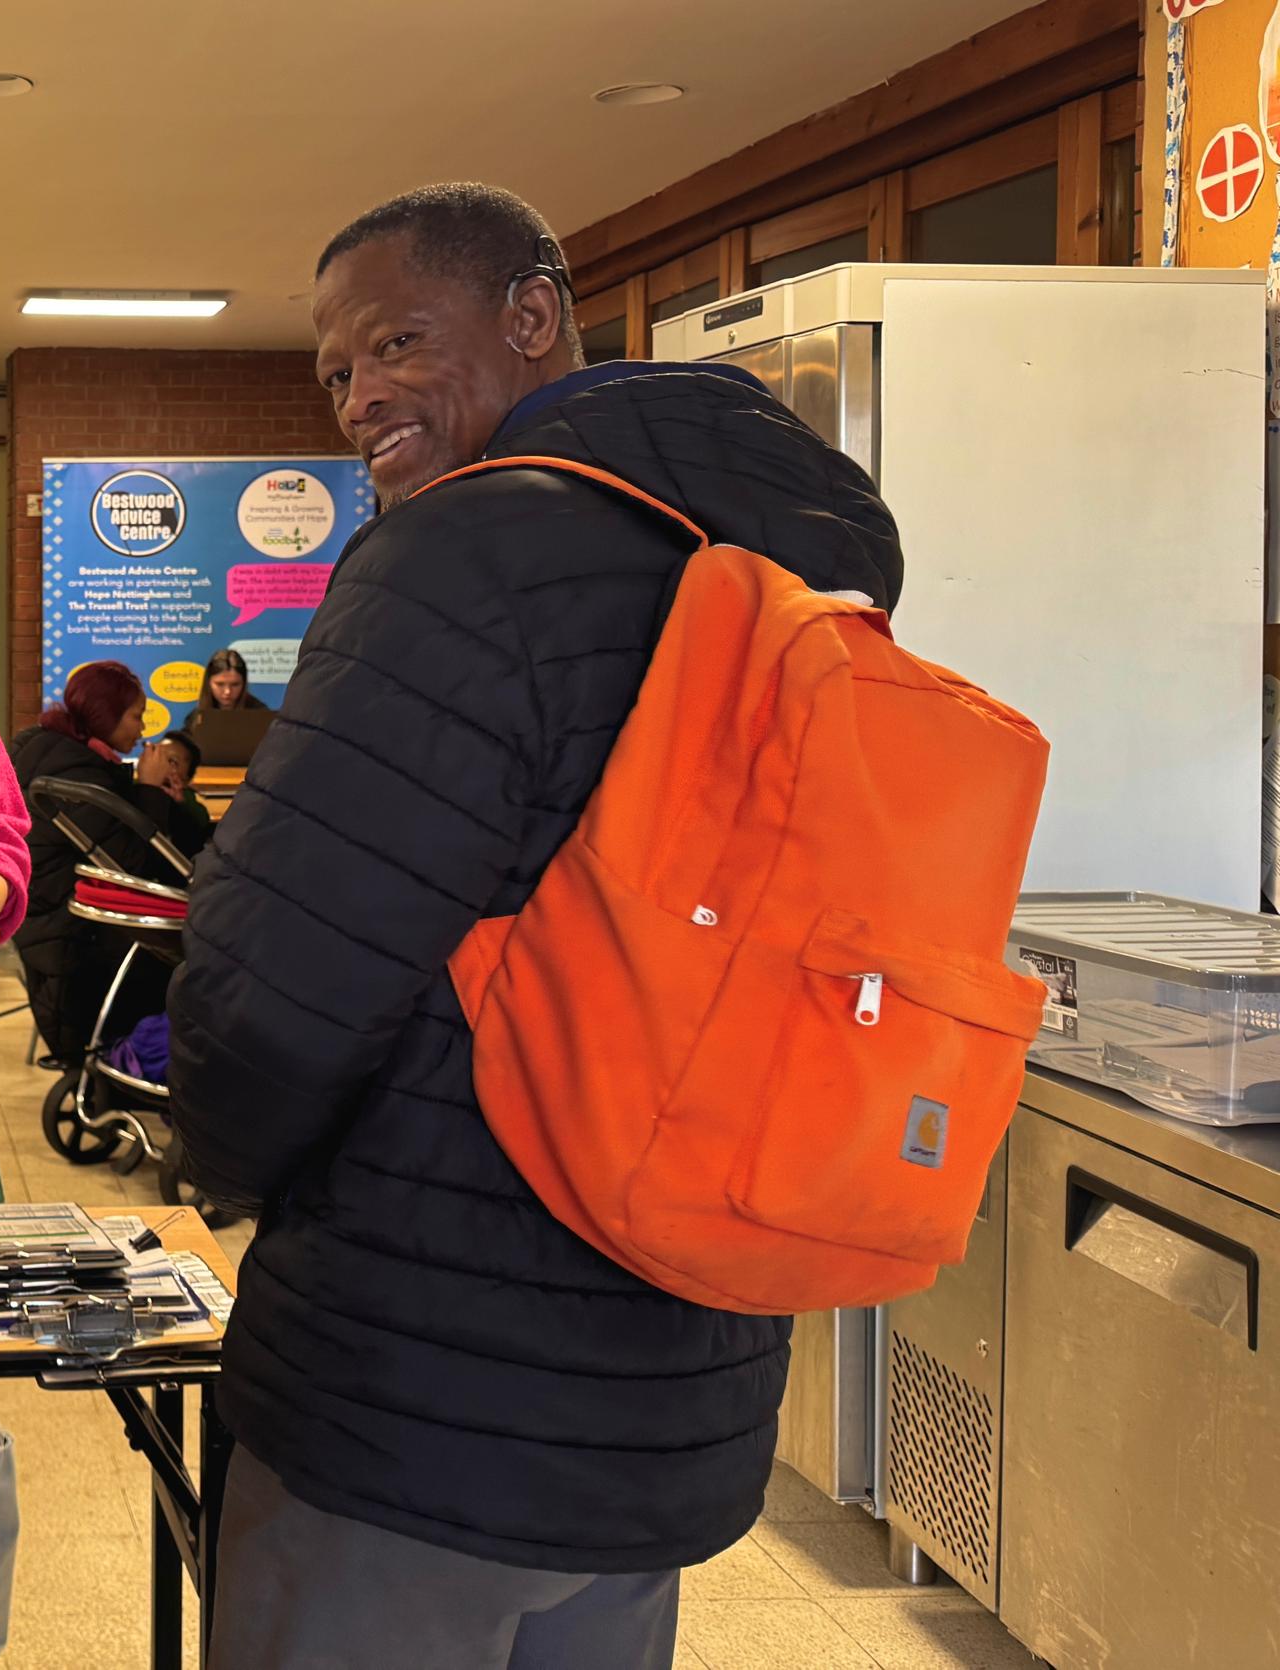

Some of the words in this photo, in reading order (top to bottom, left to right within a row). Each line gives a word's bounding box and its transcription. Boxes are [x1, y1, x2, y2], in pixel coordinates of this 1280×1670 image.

[102, 493, 175, 509] Bestwood
[250, 505, 281, 514] Inspiring
[292, 505, 324, 513] Growing
[110, 509, 161, 525] Advice
[246, 515, 295, 523] Communities
[297, 515, 305, 523] of
[307, 515, 327, 523] Hope
[120, 526, 171, 540] Centre
[79, 566, 126, 575] Bestwood
[128, 566, 161, 575] Advice
[163, 566, 197, 575] Centre
[87, 578, 123, 588] working
[136, 578, 189, 588] partnership
[192, 578, 211, 586] with
[84, 591, 110, 600] Hope
[112, 589, 171, 600] Nottingham
[173, 589, 192, 598] and
[68, 601, 86, 610] The
[88, 601, 123, 610] Trussell
[125, 601, 148, 610] Trust
[151, 602, 158, 610] in
[161, 602, 210, 612] supporting
[78, 612, 110, 623] people
[113, 613, 147, 624] coming
[150, 613, 159, 621] to
[162, 612, 177, 621] the
[179, 612, 201, 621] food
[67, 624, 90, 633] bank
[93, 624, 111, 633] with
[114, 624, 152, 635] welfare,
[154, 624, 191, 633] benefits
[193, 624, 212, 633] and
[92, 636, 132, 645] financial
[134, 636, 184, 645] difficulties.
[163, 670, 200, 680] Benefit
[163, 684, 198, 694] checks
